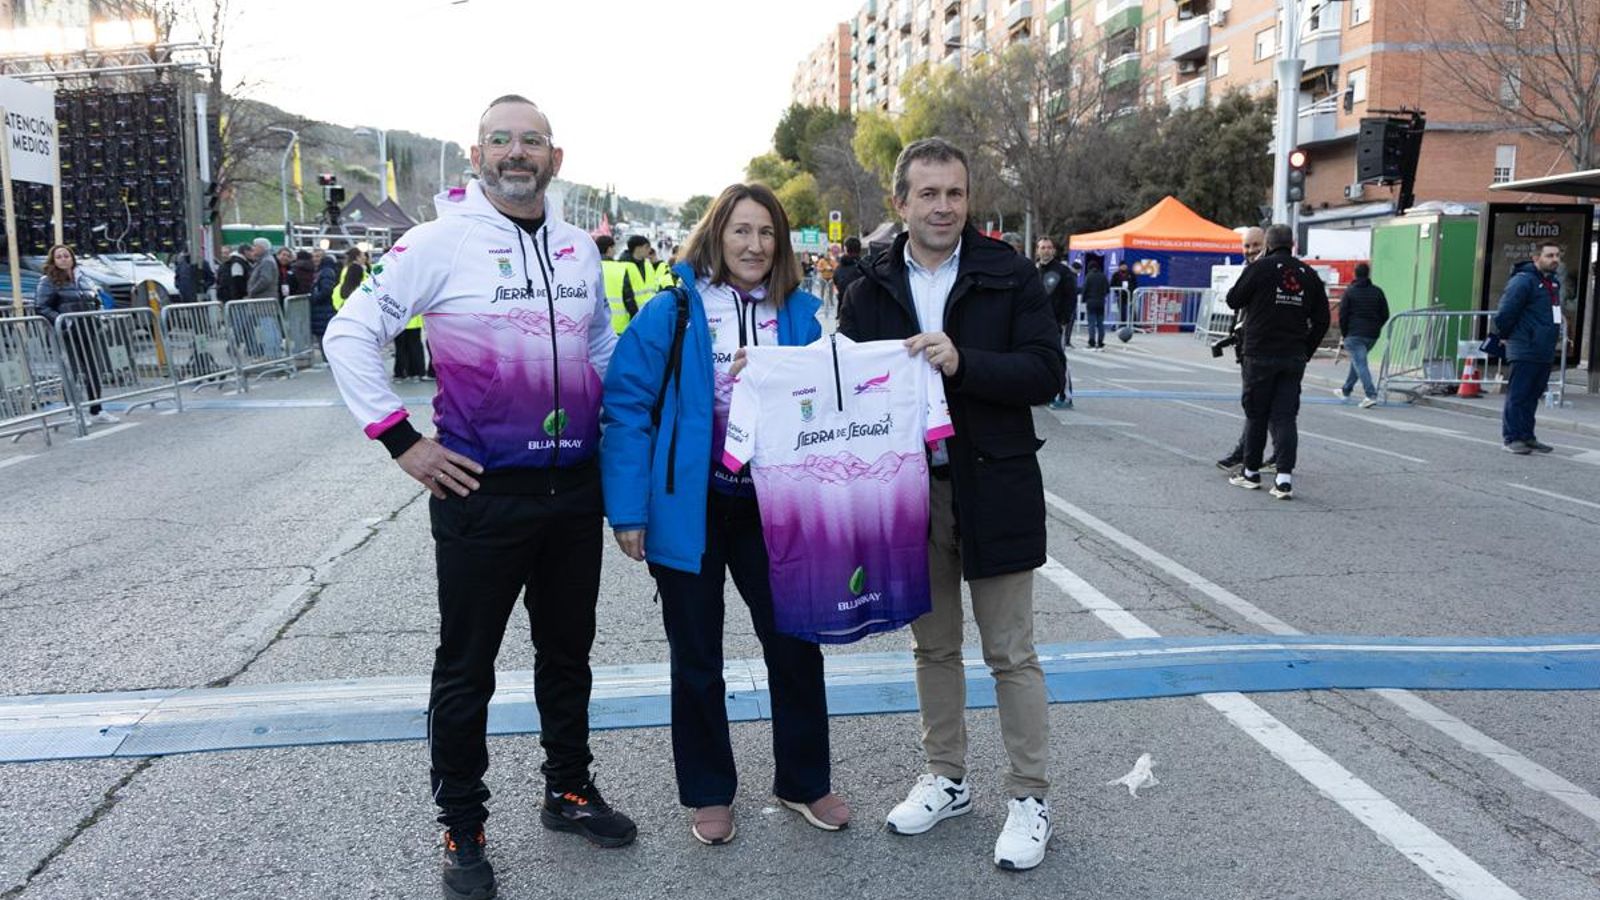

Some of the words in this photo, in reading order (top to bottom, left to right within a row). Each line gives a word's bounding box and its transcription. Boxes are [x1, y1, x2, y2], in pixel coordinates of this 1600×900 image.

[5, 112, 53, 137] ATENCIÓN
[13, 134, 50, 156] MEDIOS
[1517, 221, 1560, 236] ultima
[491, 286, 535, 303] SIERRA
[536, 288, 547, 297] DE
[554, 284, 588, 301] SEGURA
[793, 429, 835, 451] SIERRA
[836, 427, 847, 438] DE
[845, 421, 889, 441] SEGURA
